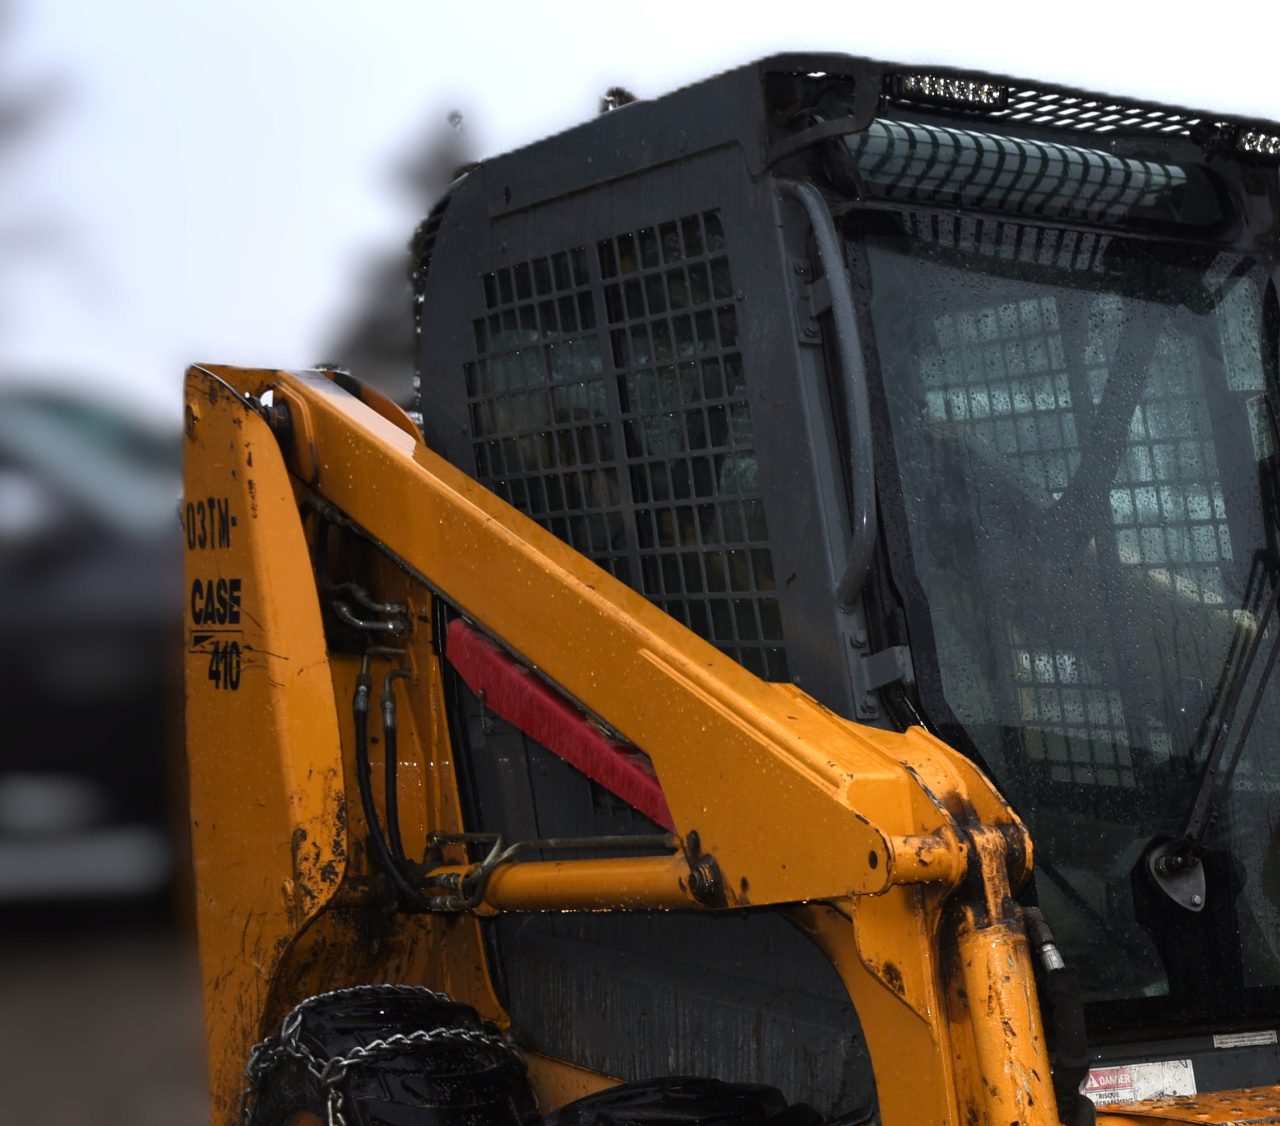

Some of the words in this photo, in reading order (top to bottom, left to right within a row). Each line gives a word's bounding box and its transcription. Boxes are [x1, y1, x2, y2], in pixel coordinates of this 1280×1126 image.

[191, 578, 241, 625] CASE
[208, 640, 241, 691] 410
[1099, 1074, 1131, 1086] DANGER
